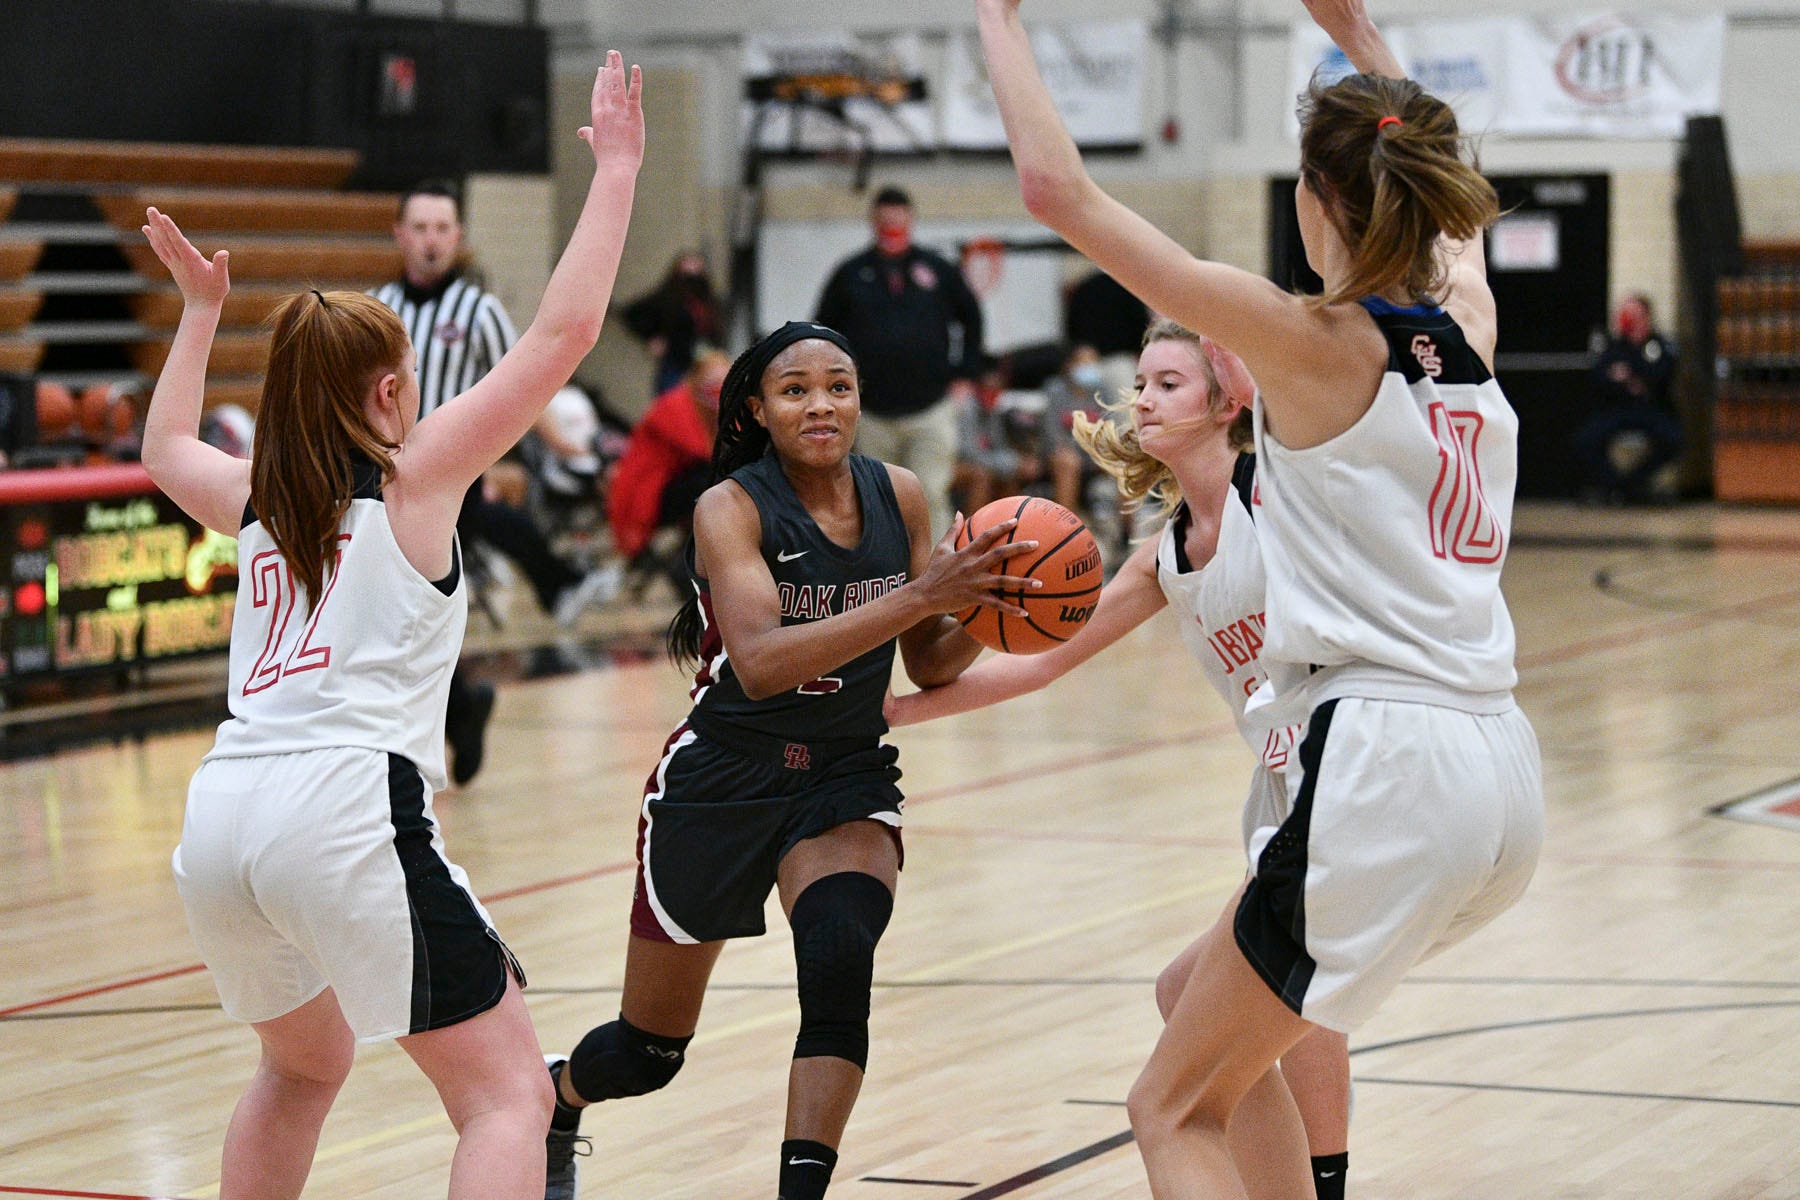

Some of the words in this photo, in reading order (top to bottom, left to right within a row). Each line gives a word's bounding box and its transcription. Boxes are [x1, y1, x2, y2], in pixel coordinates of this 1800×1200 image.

[1428, 402, 1503, 564] 10
[242, 533, 352, 696] 22
[778, 582, 836, 619] OAK
